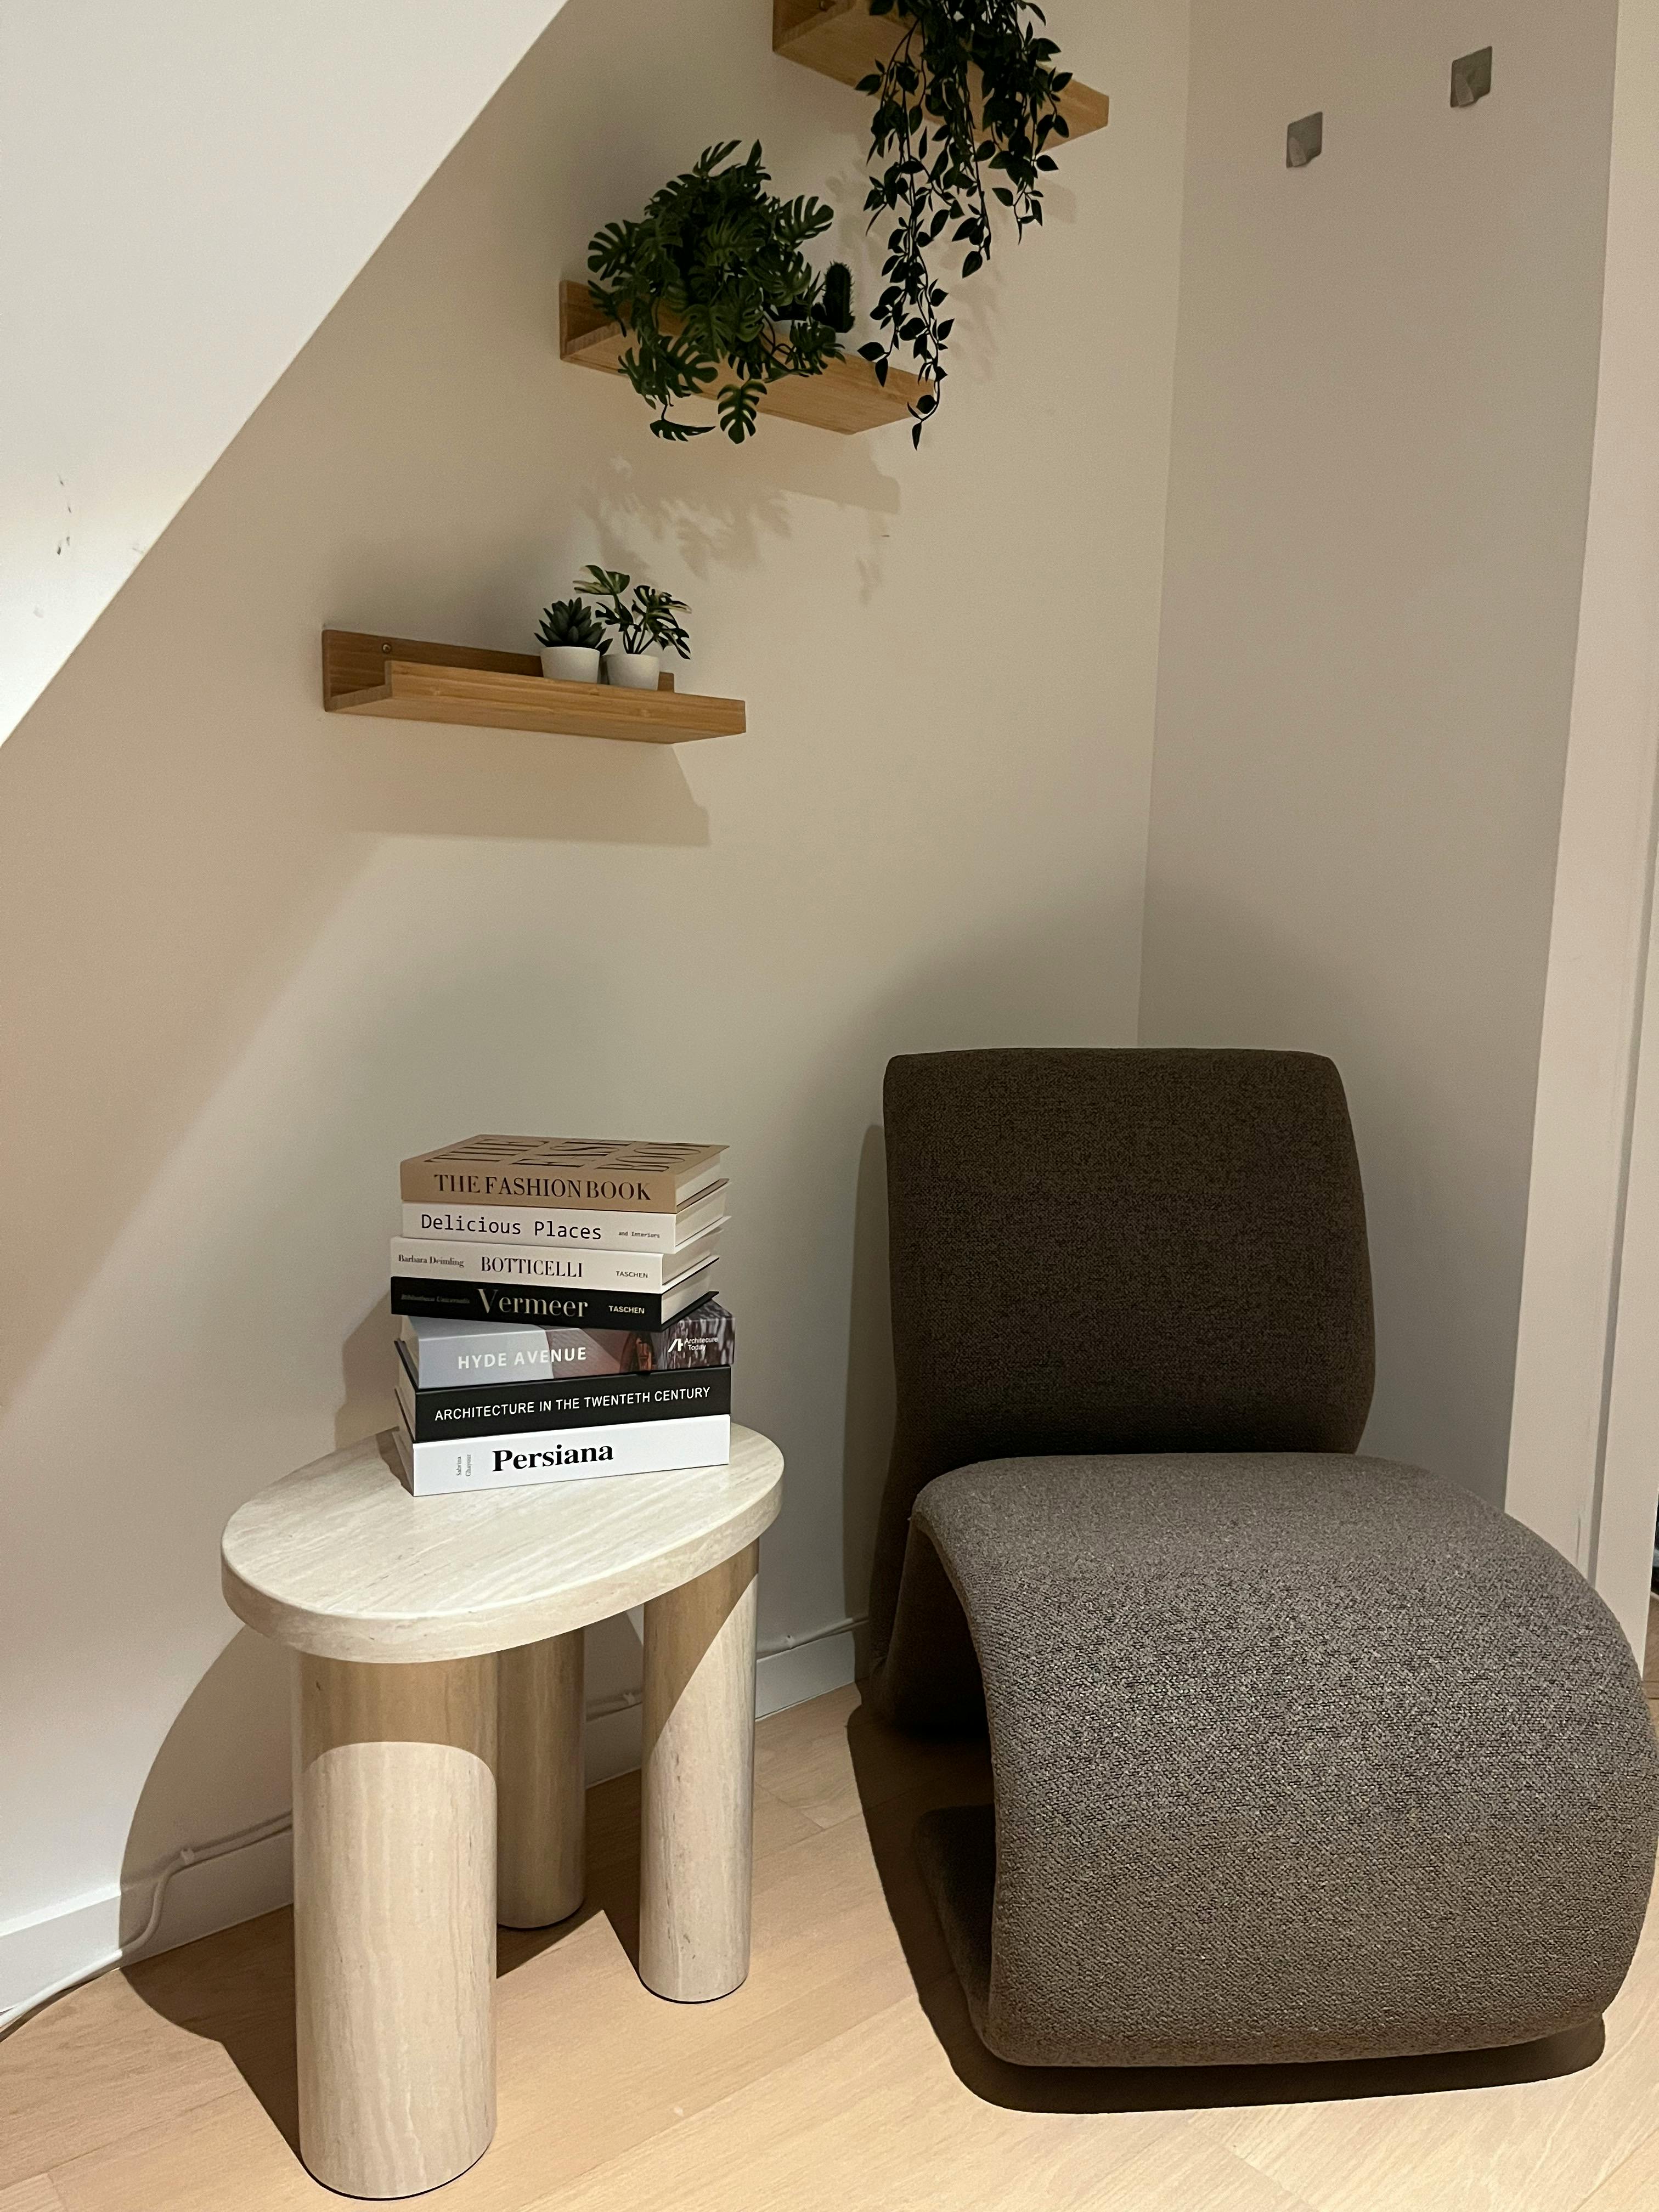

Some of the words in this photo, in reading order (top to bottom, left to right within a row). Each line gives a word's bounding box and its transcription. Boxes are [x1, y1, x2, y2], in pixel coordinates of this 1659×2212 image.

[434, 1174, 481, 1193] THE
[485, 1176, 582, 1198] FASHION
[587, 1180, 651, 1200] BOOK
[421, 1214, 521, 1235] Delicious
[534, 1221, 601, 1240] Places
[399, 1254, 427, 1263] Barbara
[481, 1256, 583, 1278] BOTTICELLI
[478, 1289, 589, 1317] Vermeer
[608, 1305, 645, 1314] TASCHEN
[458, 1352, 507, 1369] HYDE
[514, 1347, 586, 1365] AVENUE
[435, 1402, 534, 1421] ARCHITECTURE
[539, 1400, 551, 1412] IN
[555, 1398, 580, 1410] THE
[584, 1392, 650, 1408] TWENTETH
[654, 1386, 710, 1402] CENTURY
[492, 1444, 614, 1472] Persiana
